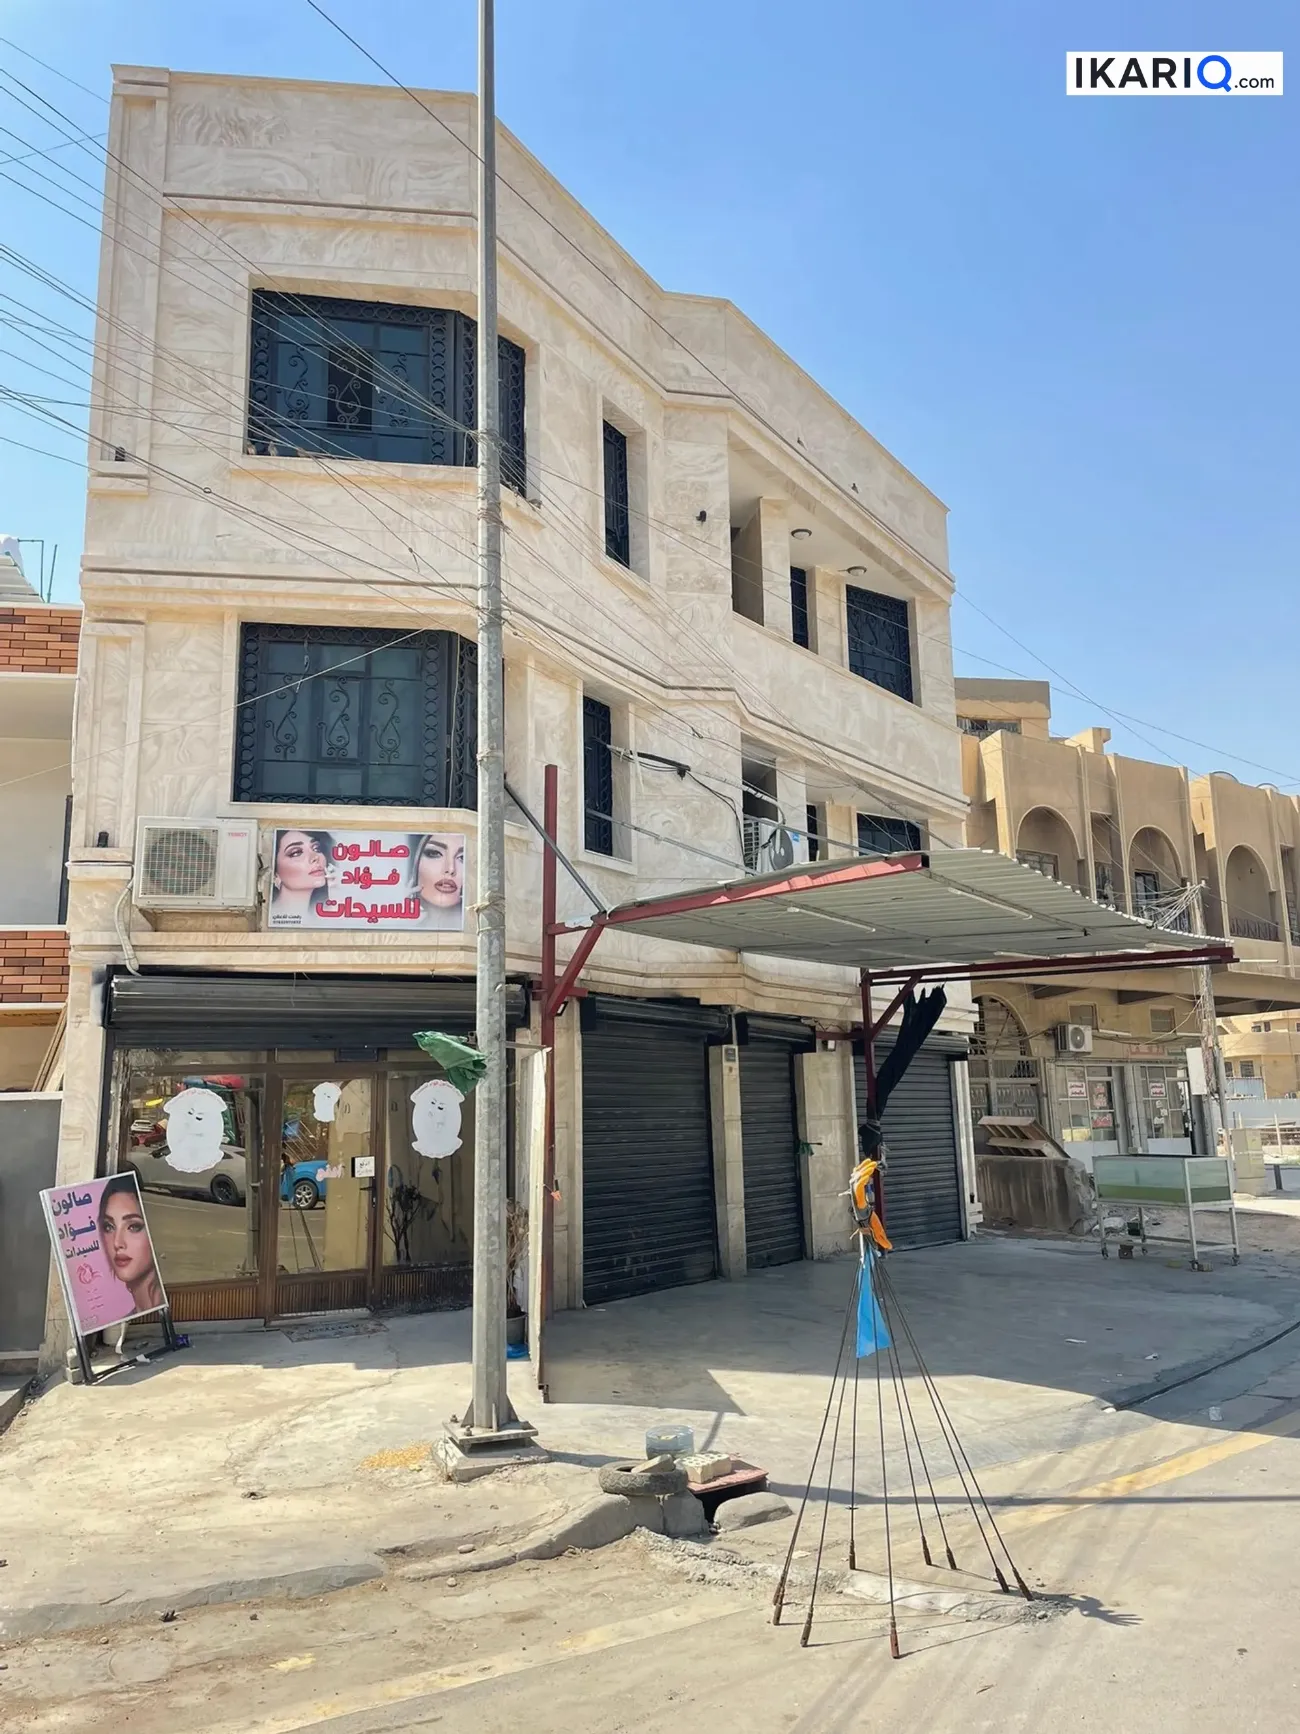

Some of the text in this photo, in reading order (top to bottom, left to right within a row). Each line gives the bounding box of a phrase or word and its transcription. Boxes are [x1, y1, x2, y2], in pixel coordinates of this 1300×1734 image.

[332, 840, 410, 861] صالون
[341, 866, 400, 889] فؤاد
[315, 897, 421, 923] للسيدات
[52, 1191, 92, 1216] صالون
[58, 1216, 96, 1241] فؤاد
[65, 1240, 99, 1258] للسيدات
